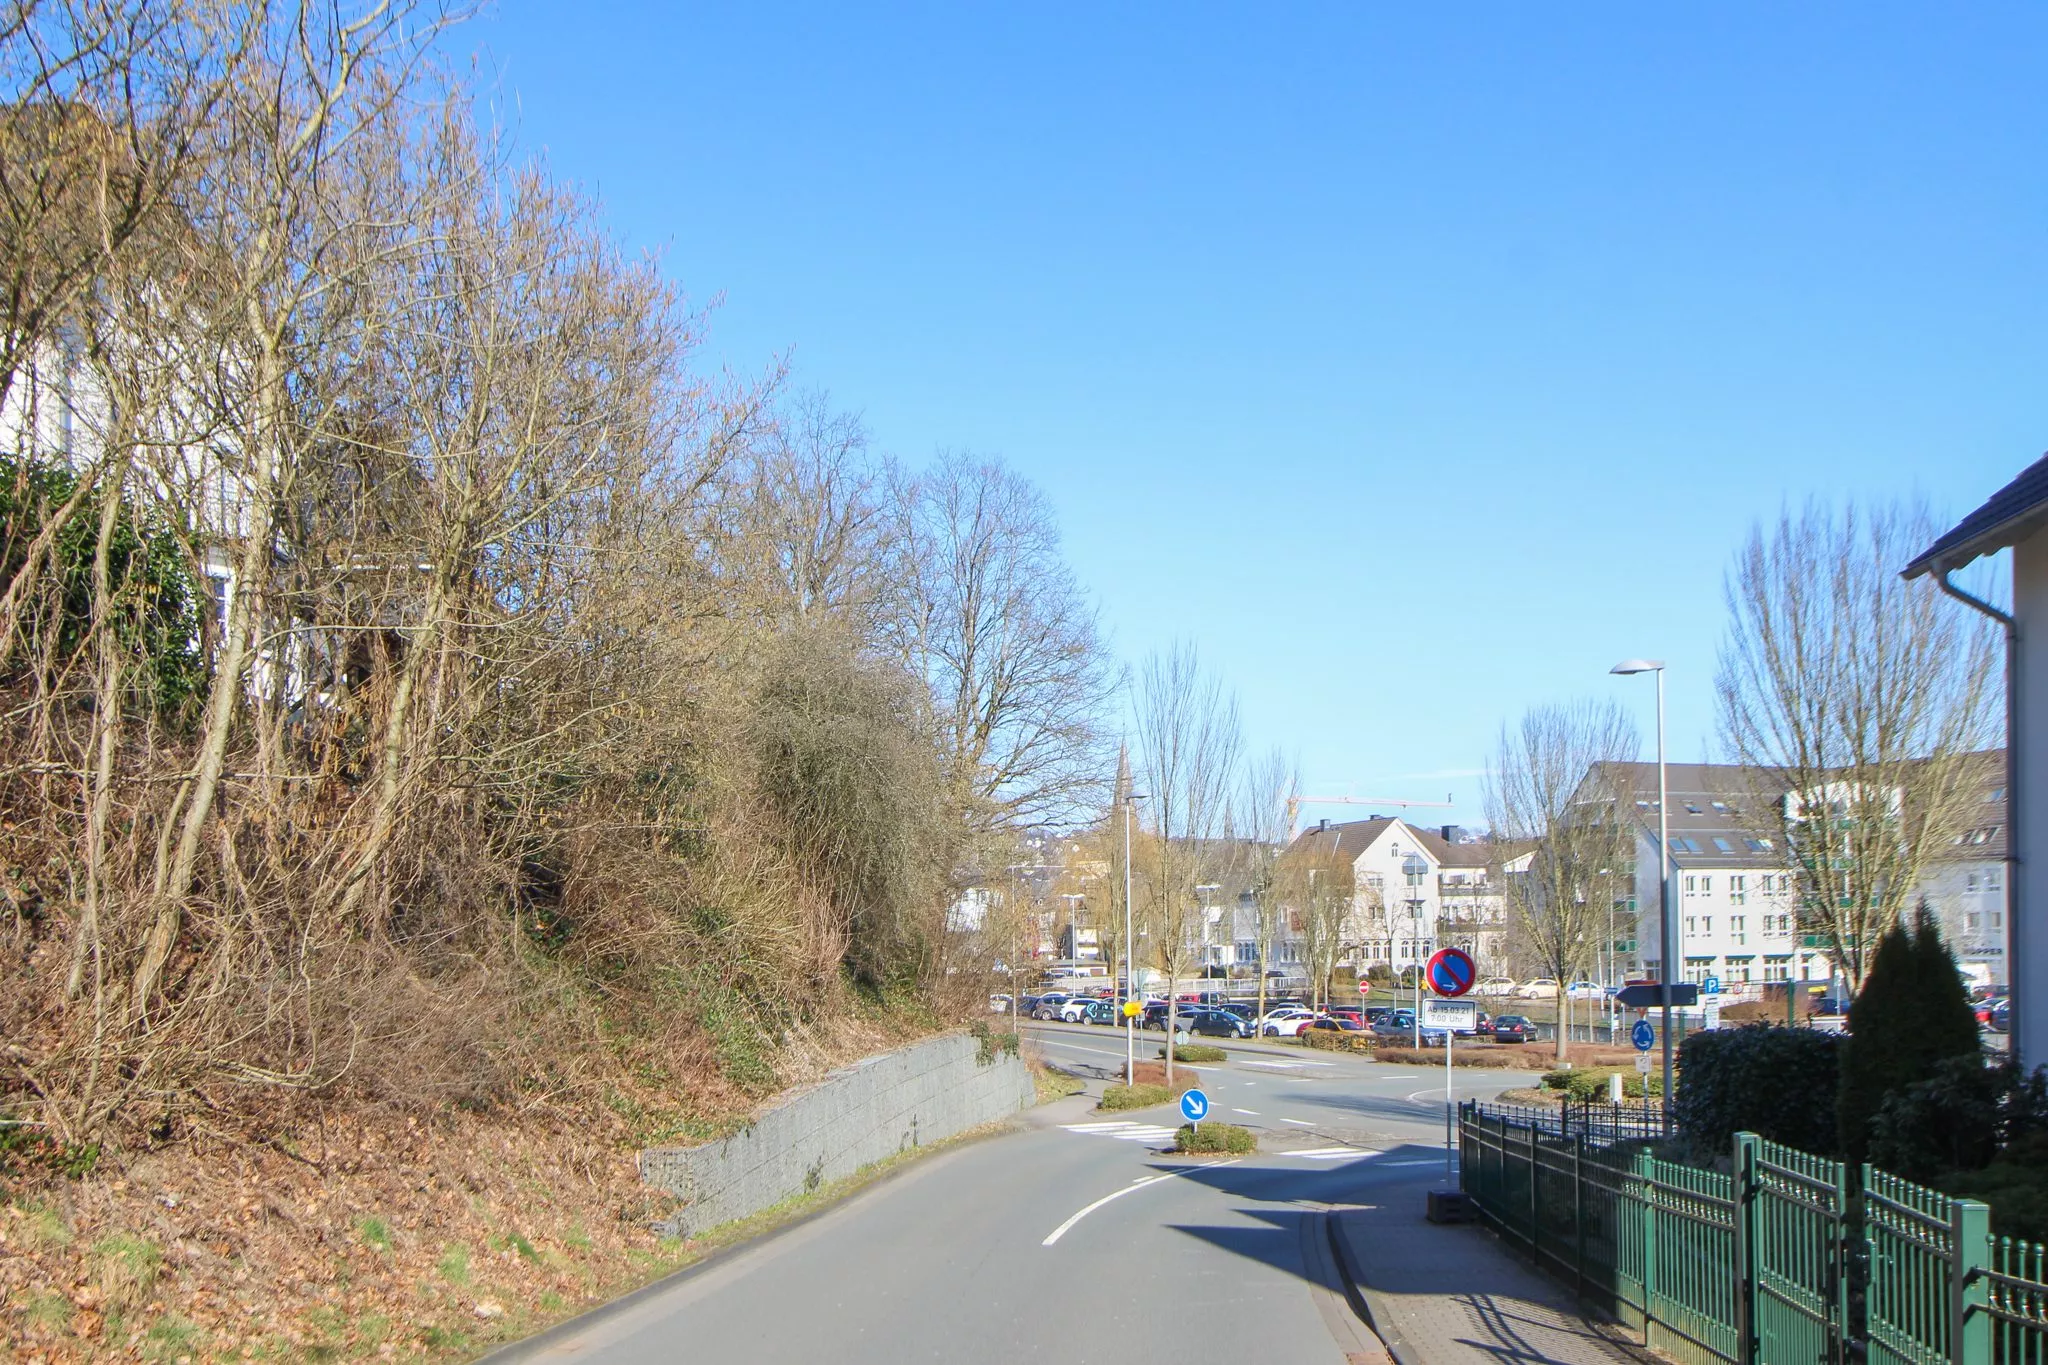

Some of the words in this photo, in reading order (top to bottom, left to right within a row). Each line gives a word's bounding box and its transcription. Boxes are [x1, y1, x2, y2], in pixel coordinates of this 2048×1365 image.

[1708, 979, 1717, 993] P
[1427, 1005, 1438, 1013] Ab
[1450, 1015, 1464, 1023] Uhr
